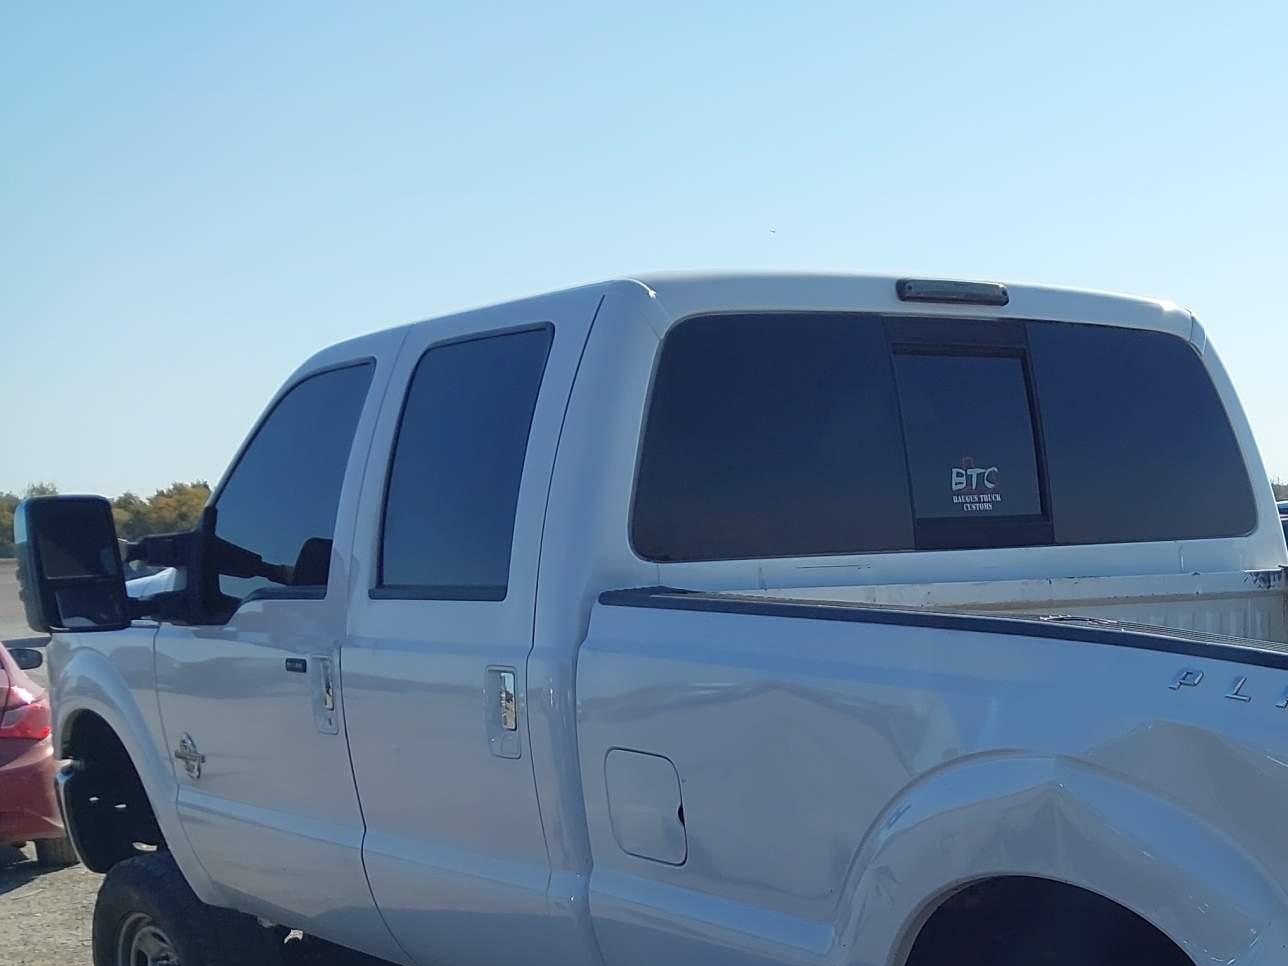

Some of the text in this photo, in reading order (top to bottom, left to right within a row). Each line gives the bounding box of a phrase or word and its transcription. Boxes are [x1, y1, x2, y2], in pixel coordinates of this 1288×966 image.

[952, 466, 998, 491] BTC
[980, 494, 1001, 502] TRUCK
[963, 503, 993, 511] CUSTOMS
